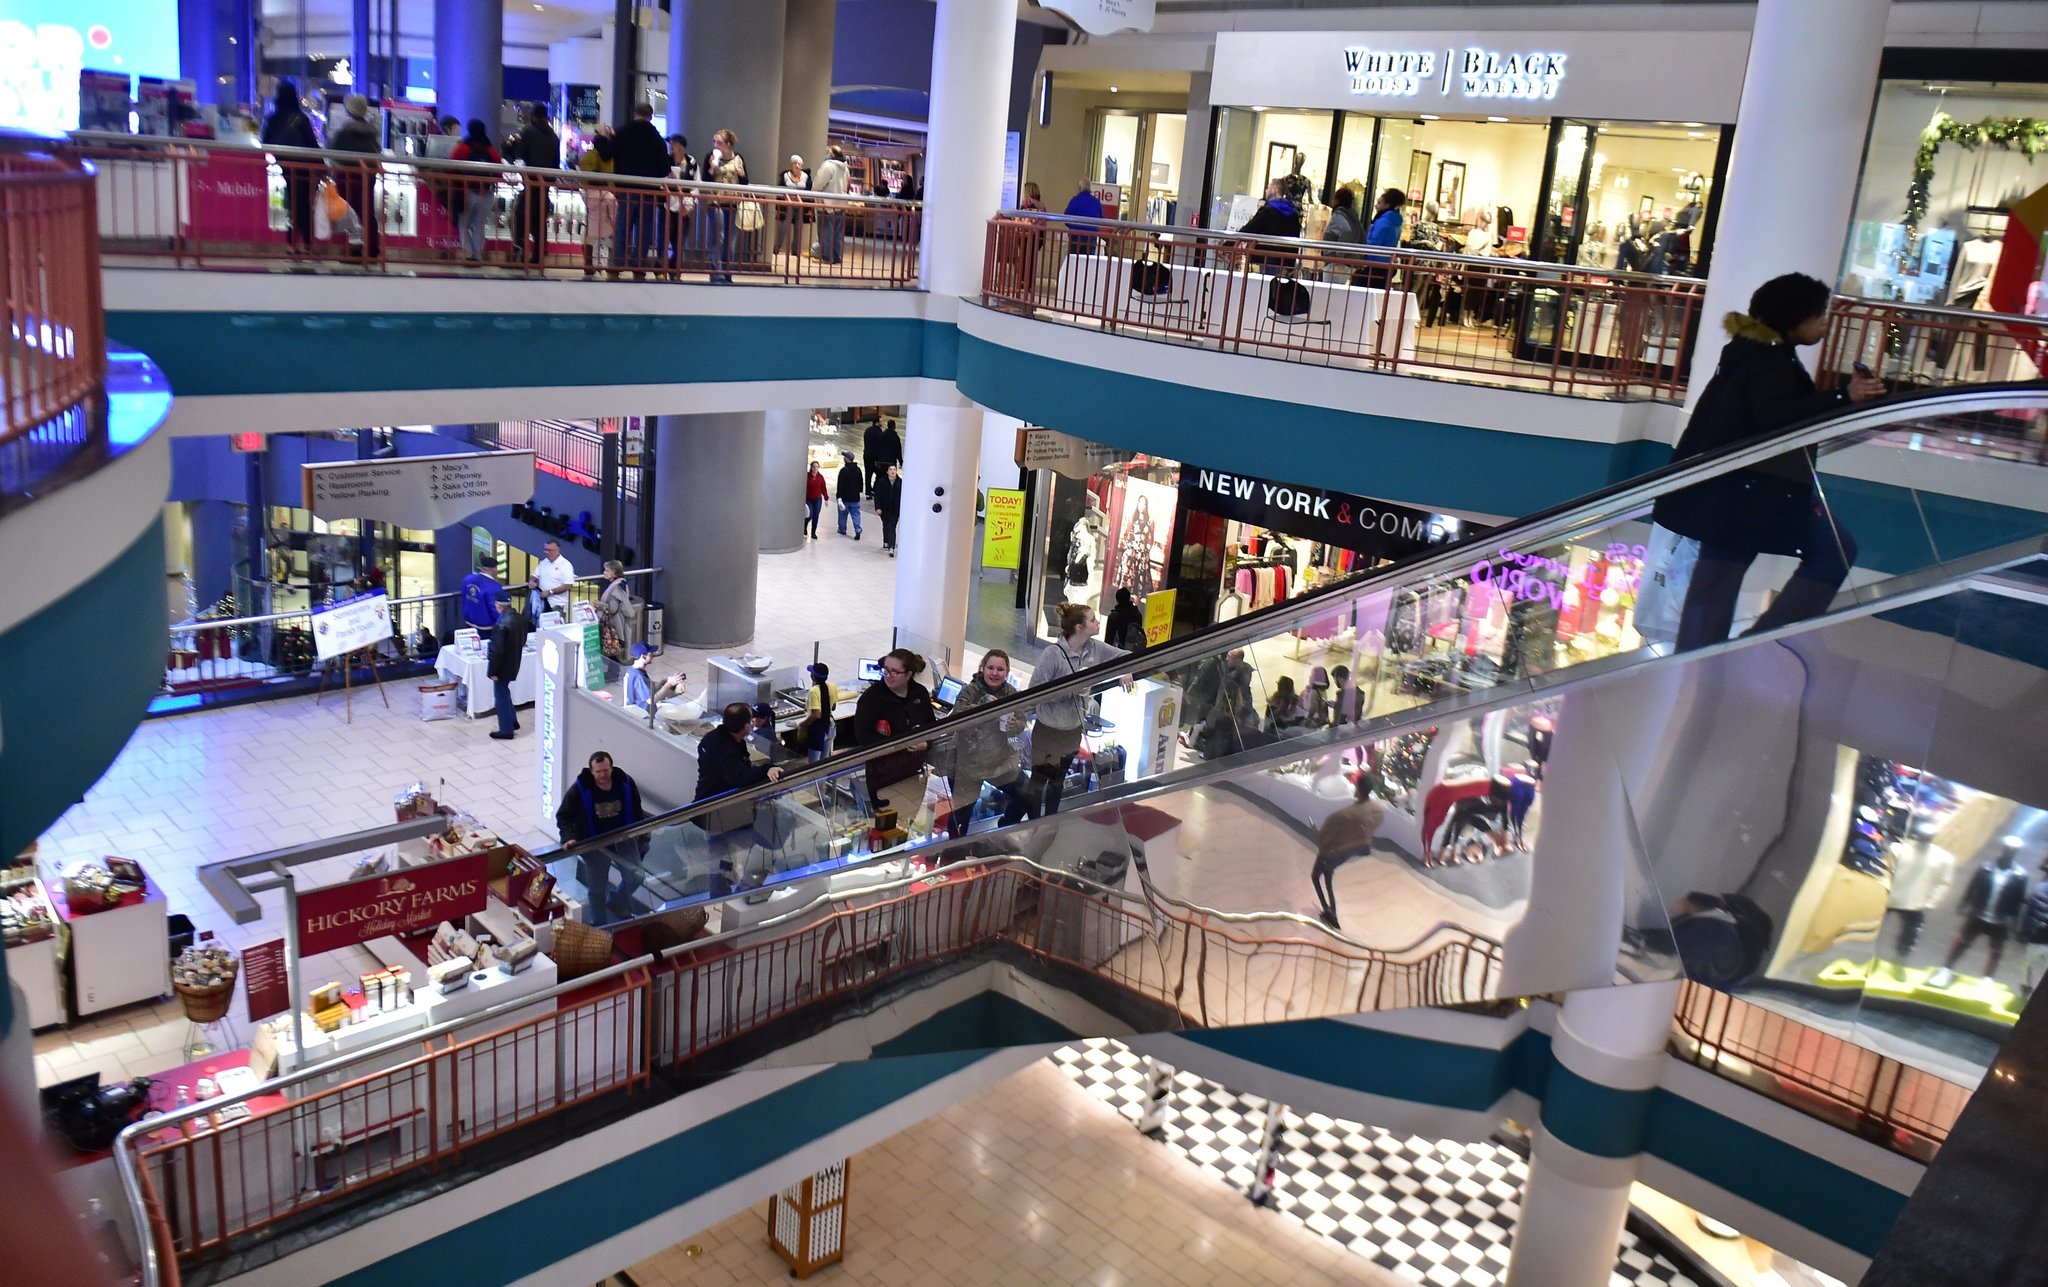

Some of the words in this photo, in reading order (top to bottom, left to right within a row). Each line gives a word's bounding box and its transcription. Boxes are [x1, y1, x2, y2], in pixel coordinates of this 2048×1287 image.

[1344, 49, 1432, 74] WHITE
[1462, 49, 1567, 76] BLACK
[1351, 77, 1414, 92] HOUSE
[1463, 79, 1552, 96] MARKET
[1054, 453, 1070, 461] Service
[441, 463, 469, 473] Macy's
[327, 471, 368, 480] Customer
[370, 468, 402, 477] Service
[441, 473, 453, 481] JC
[454, 472, 482, 481] Penney
[328, 480, 374, 490] Restrooms
[442, 482, 461, 491] Saks
[462, 480, 474, 489] Off
[328, 491, 356, 500] Yellow
[357, 488, 390, 497] Parking
[442, 491, 466, 500] Outlet
[467, 489, 491, 498] Shops
[1198, 469, 1255, 501] NEW
[1262, 483, 1331, 520] YORK
[1336, 502, 1352, 525] &
[989, 496, 1022, 506] TODAY!
[306, 897, 408, 933] HICKORY
[411, 879, 477, 908] FARMS
[358, 918, 400, 938] Holiday
[397, 908, 432, 928] Market
